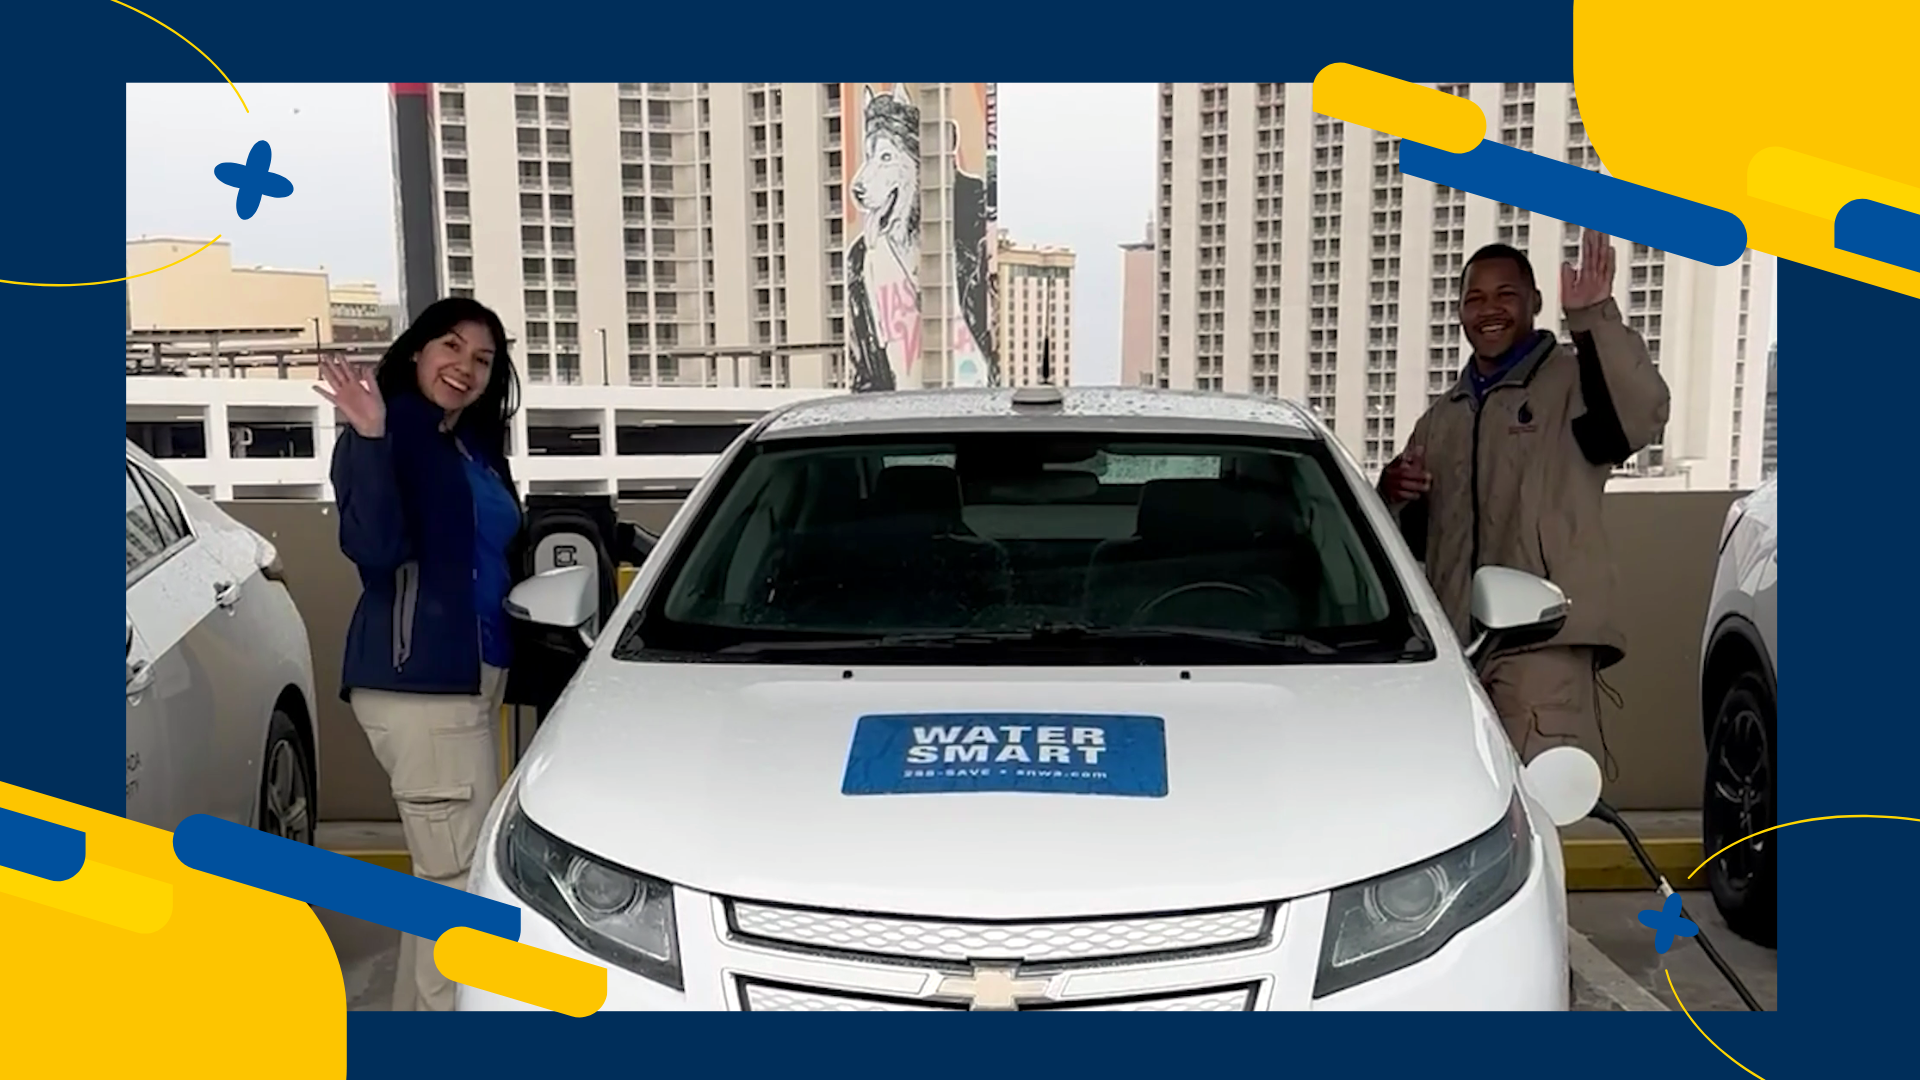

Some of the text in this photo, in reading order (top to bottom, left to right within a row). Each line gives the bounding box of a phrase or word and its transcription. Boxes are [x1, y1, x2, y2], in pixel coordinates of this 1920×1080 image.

[912, 726, 1105, 745] WATER
[906, 744, 1107, 764] SMART
[1016, 769, 1107, 779] snwa.com
